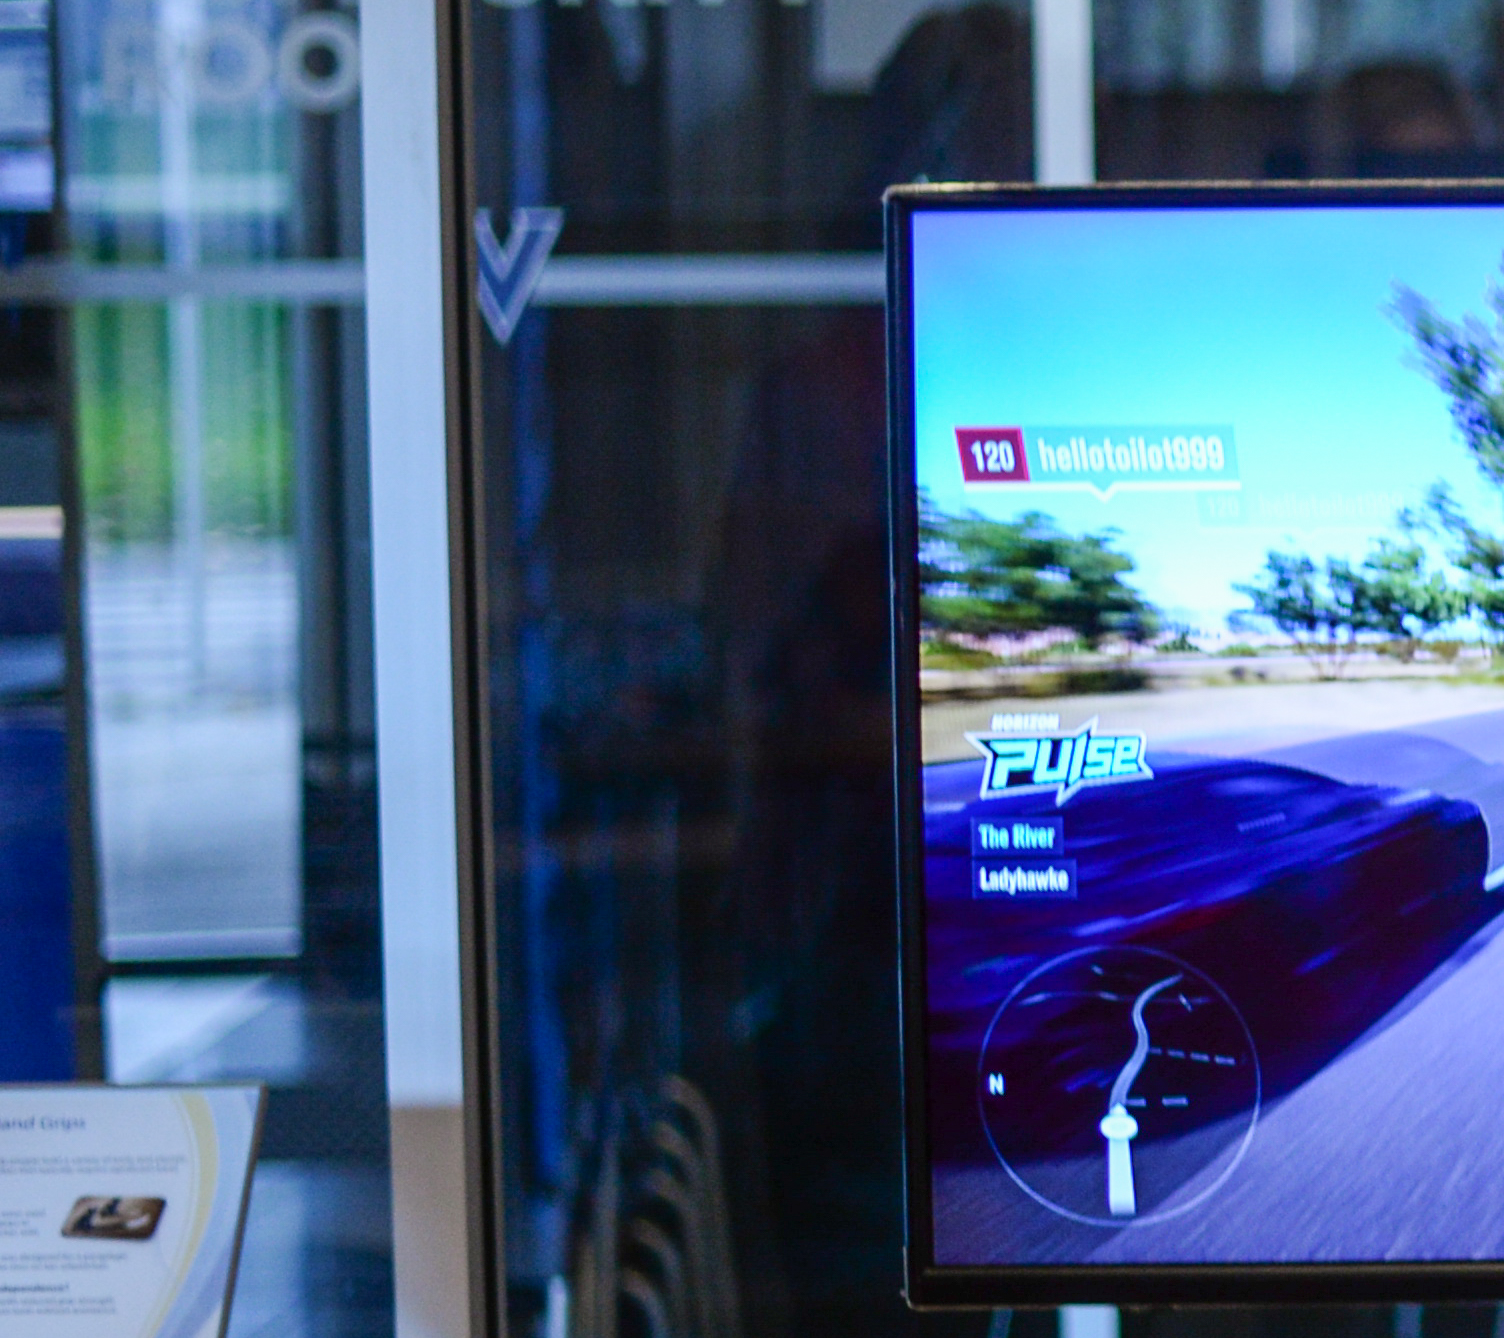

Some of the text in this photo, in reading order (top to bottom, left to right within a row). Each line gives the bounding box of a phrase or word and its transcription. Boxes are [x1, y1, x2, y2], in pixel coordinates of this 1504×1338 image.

[101, 11, 359, 112] ROO
[970, 439, 1015, 474] 120
[978, 822, 1055, 850] The River
[988, 1073, 1005, 1096] N
